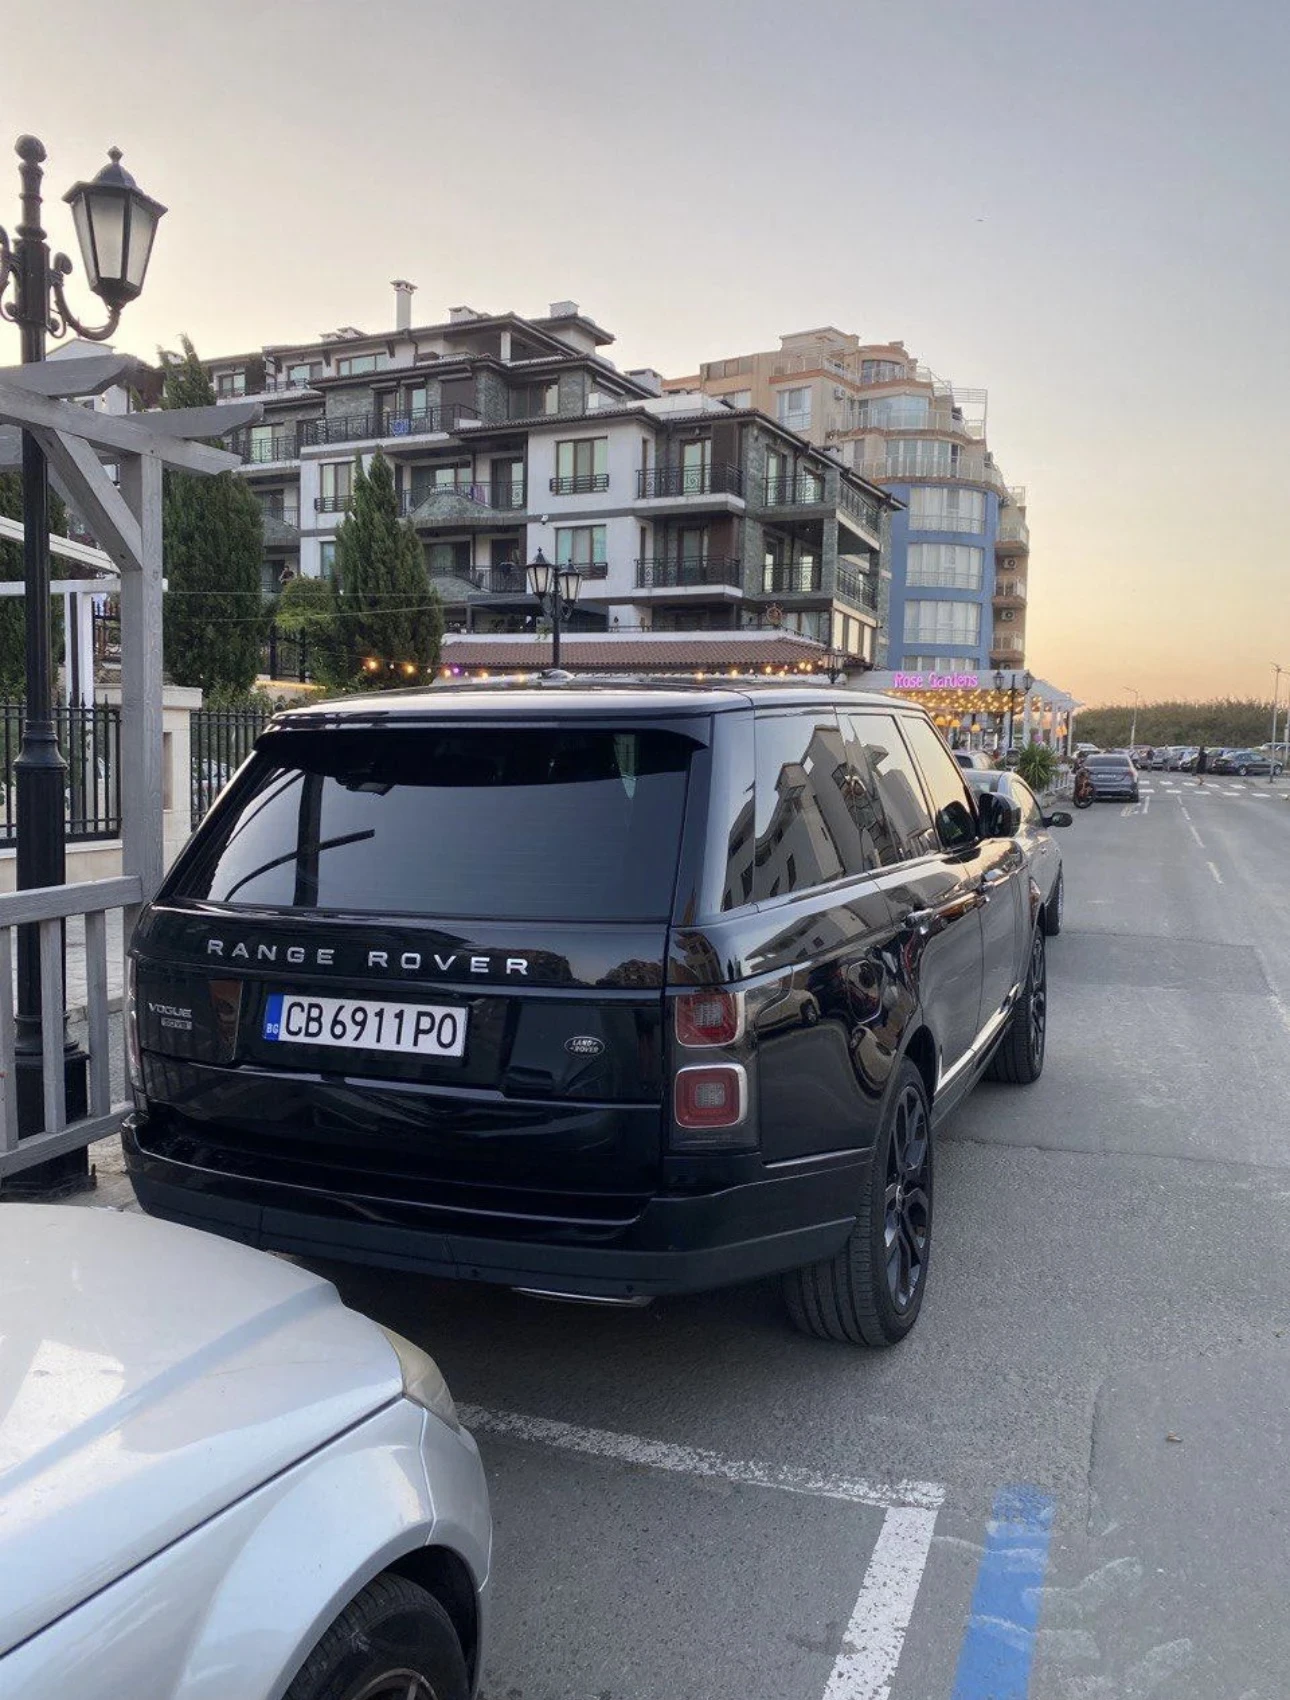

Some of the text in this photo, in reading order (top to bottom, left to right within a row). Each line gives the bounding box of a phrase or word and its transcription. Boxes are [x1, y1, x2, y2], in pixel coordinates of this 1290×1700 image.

[894, 672, 979, 689] Rose Gardens
[206, 938, 529, 976] RANGE ROVER
[148, 1002, 192, 1018] VOGUE
[265, 1023, 279, 1034] BG
